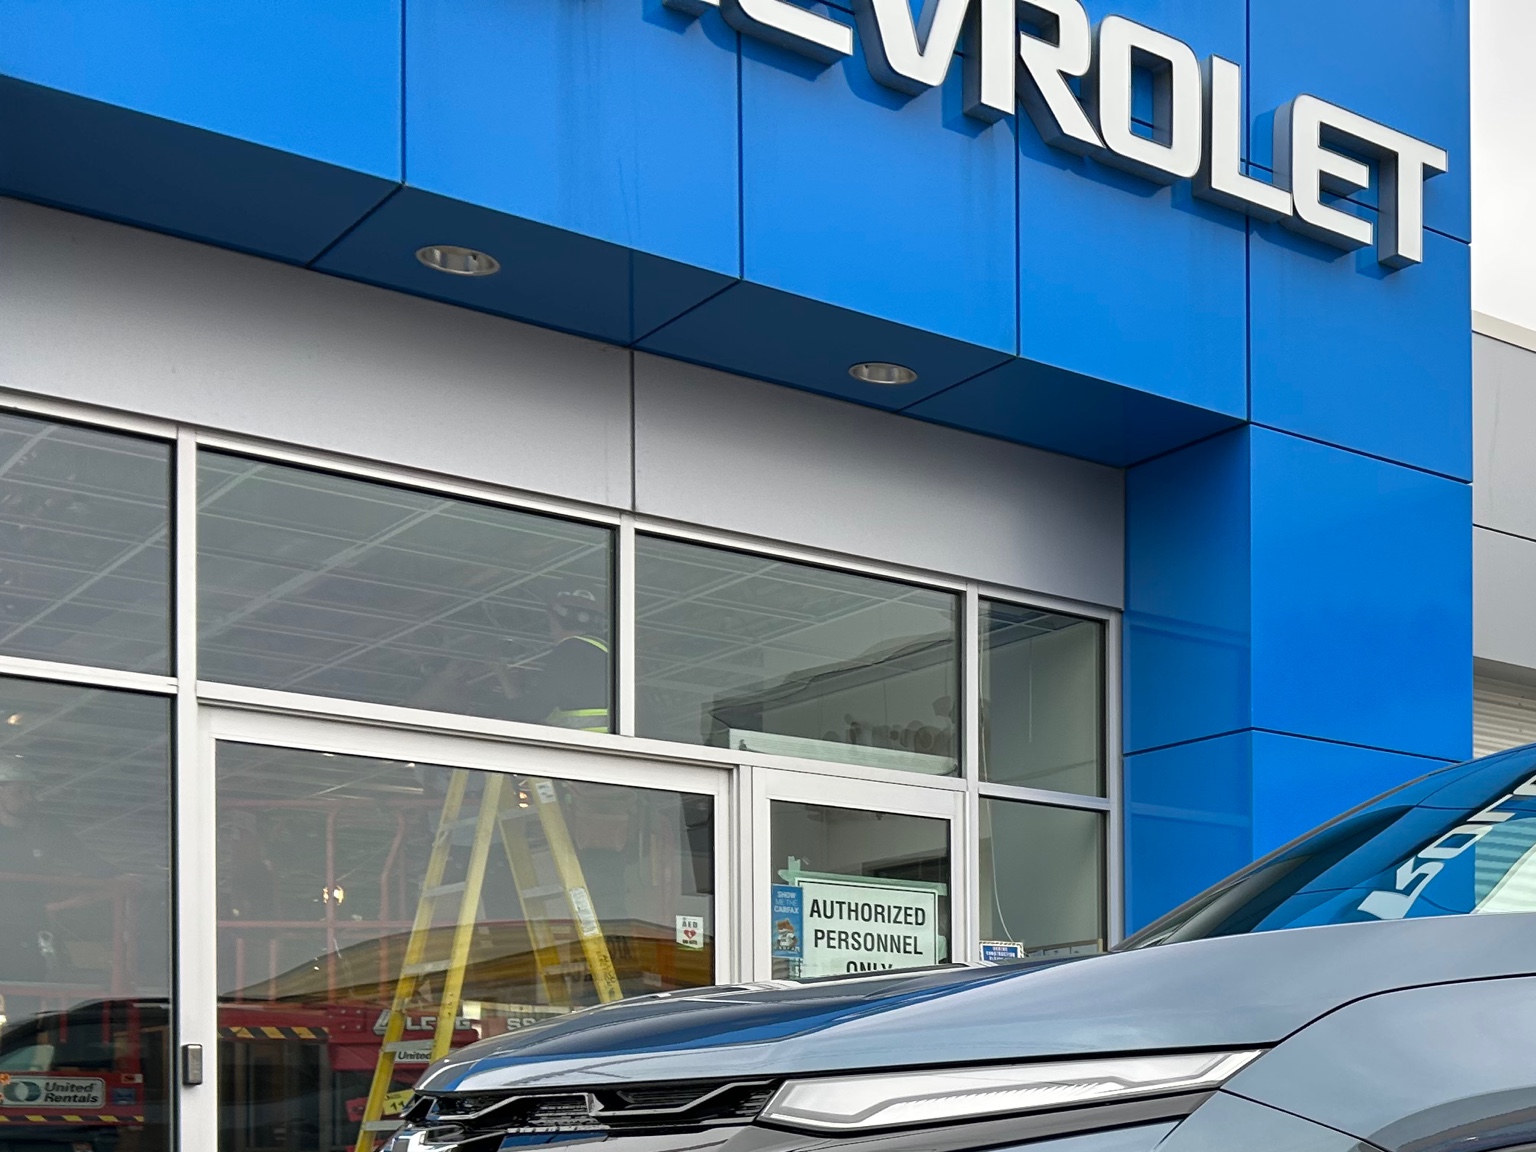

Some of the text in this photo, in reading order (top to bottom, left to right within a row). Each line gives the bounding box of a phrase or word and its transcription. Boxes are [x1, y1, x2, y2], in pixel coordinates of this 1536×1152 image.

[809, 899, 926, 926] AUTHORIZED
[814, 929, 923, 955] PERSONNEL
[44, 1082, 95, 1093] United
[44, 1093, 99, 1103] Rentals
